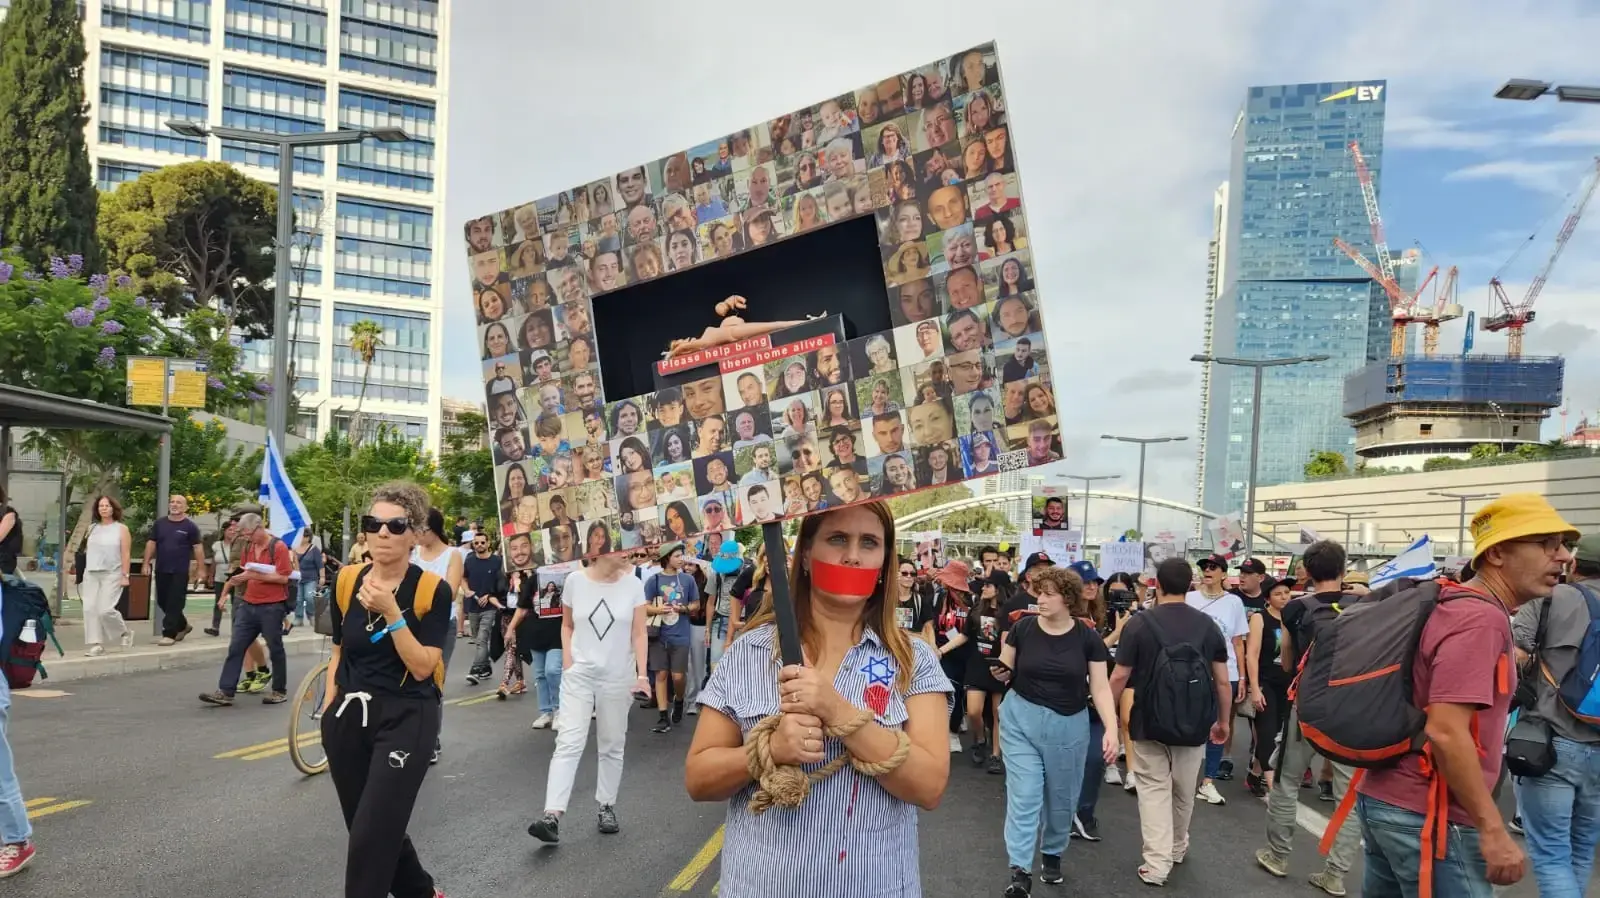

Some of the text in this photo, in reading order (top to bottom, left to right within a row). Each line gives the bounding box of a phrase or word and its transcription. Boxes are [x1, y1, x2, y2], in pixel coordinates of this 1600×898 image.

[1358, 86, 1383, 101] EY
[661, 337, 767, 369] Please help bring
[722, 338, 828, 369] them home alive.
